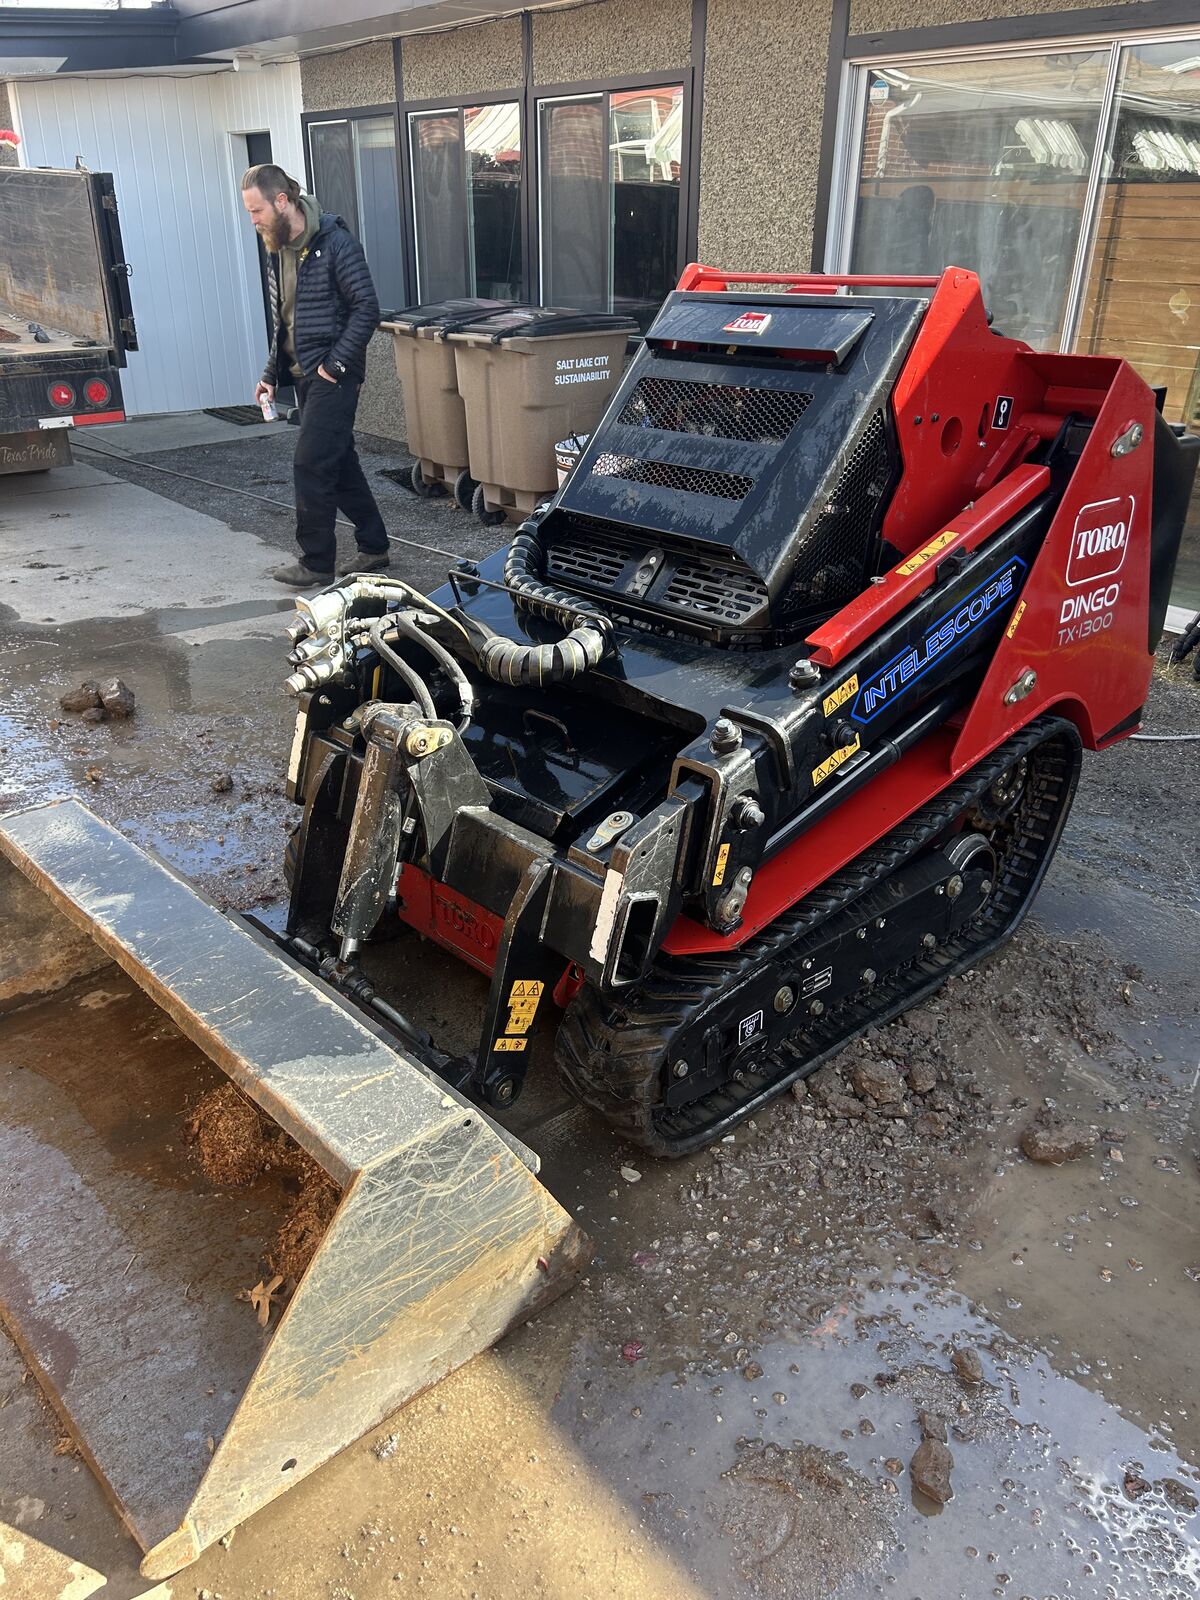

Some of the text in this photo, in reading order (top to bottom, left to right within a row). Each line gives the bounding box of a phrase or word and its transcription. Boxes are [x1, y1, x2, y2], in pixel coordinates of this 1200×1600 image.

[554, 369, 611, 385] SUSTAINABILITY
[556, 355, 609, 371] SALT LAKE CITY
[0, 442, 57, 464] Texas Pride
[1076, 521, 1125, 560] TORO
[1059, 582, 1120, 624] DINGO
[863, 568, 1013, 714] INTELESCOPE
